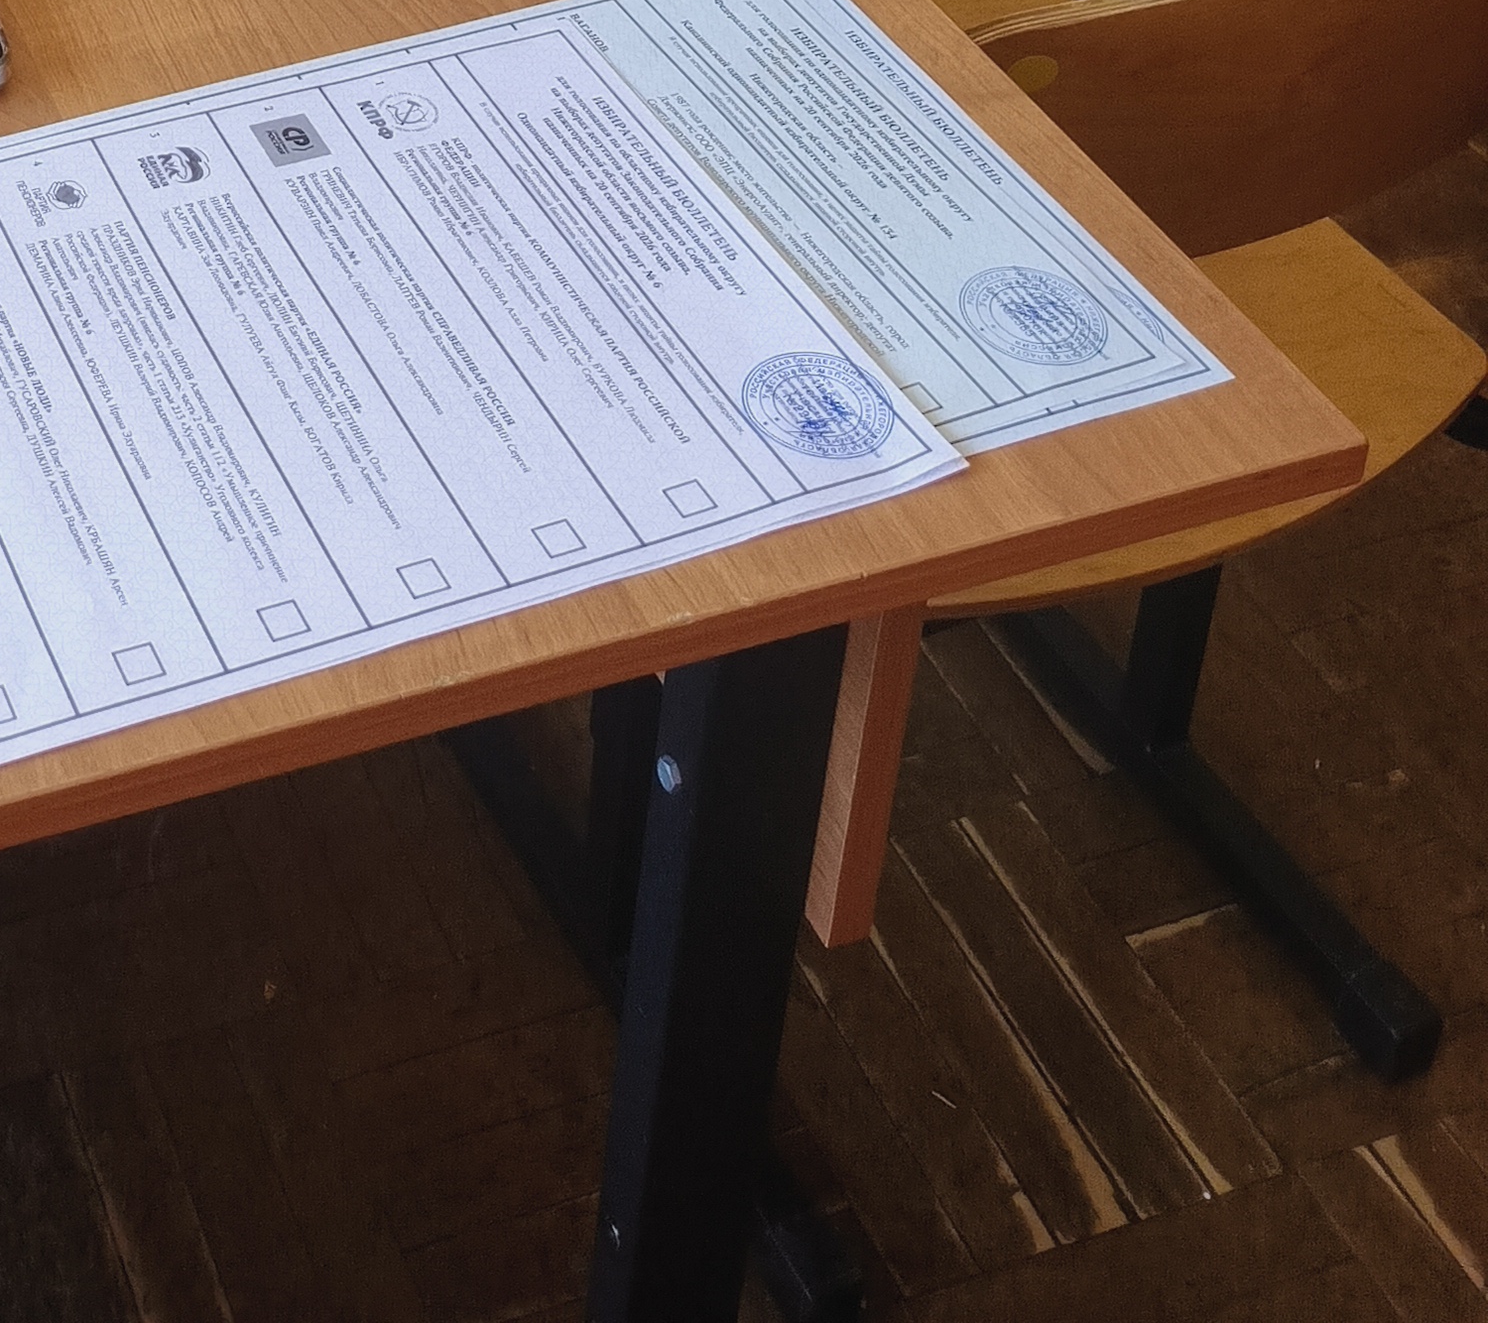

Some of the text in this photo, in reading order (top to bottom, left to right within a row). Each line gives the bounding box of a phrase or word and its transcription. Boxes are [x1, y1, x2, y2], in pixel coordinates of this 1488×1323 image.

[357, 100, 395, 141] КПРФ
[680, 20, 897, 239] Канавинский одномандатный избирательный округ № 134
[745, 47, 887, 188] назначенных на 20 сентября 2026 года
[749, 73, 836, 163] Нижегородская область
[790, 28, 947, 180] ИЗБИРАТЕЛЬНЫЙ БЮЛЛЕТЕНЬ
[844, 30, 1001, 185] ИЗБИРАТЕЛЬНЫЙ БЮЛЛЕТЕНЬ
[12, 179, 47, 227] ПЕНСИОНЕРОВ
[29, 186, 53, 214] ПАРТИЯ
[134, 157, 162, 189] РОССИЯ
[144, 154, 171, 187] ЕДИНАЯ
[440, 139, 481, 187] ФЕДЕРАЦИИ
[517, 112, 572, 176] Одномандатный
[568, 177, 625, 242] избирательный
[621, 242, 646, 269] округ
[641, 269, 656, 281] №
[593, 96, 737, 260] ИЗБИРАТЕЛЬНЫЙ БЮЛЛЕТЕНЬ
[113, 220, 175, 320] ПАРТИЯ ПЕНСИОНЕРОВ
